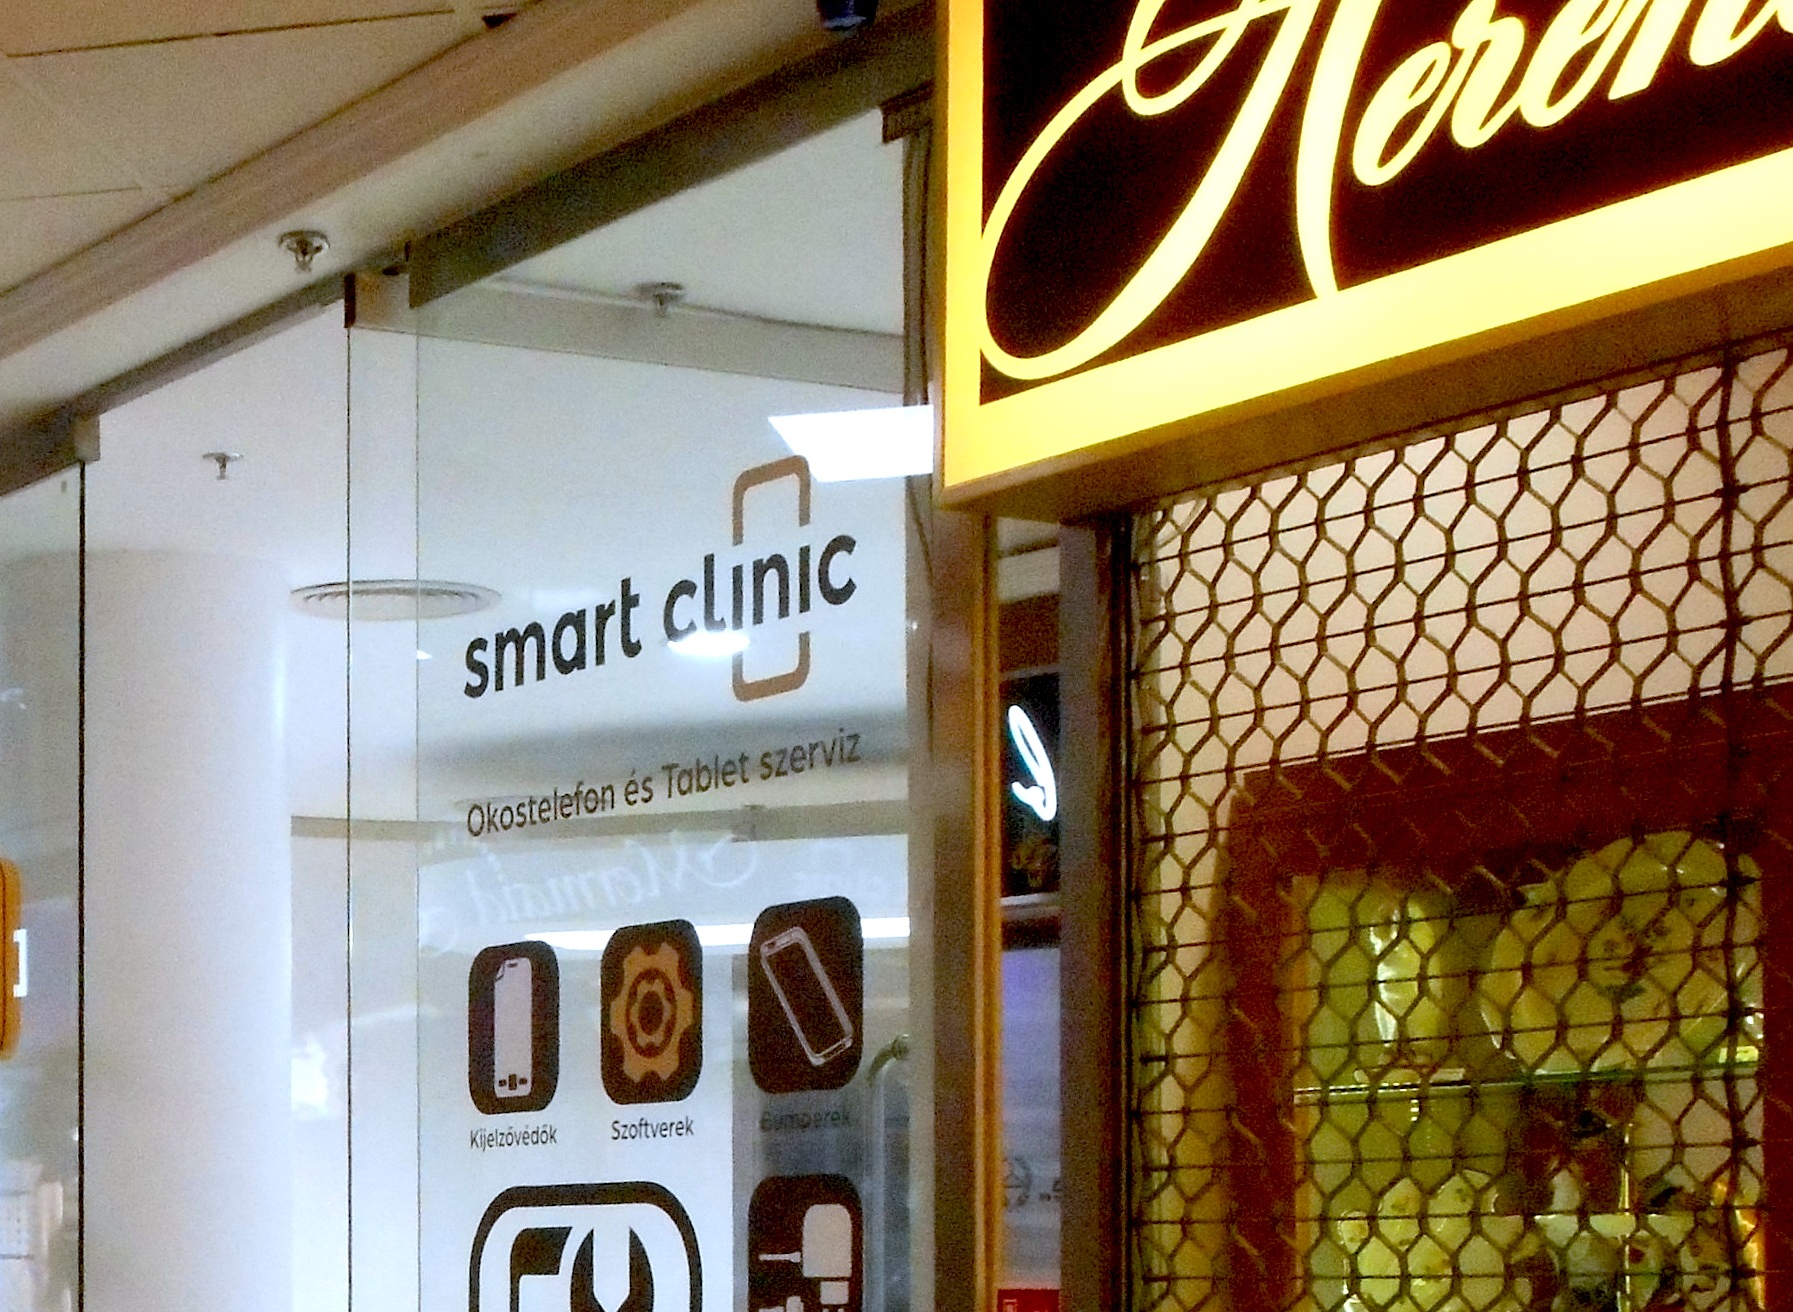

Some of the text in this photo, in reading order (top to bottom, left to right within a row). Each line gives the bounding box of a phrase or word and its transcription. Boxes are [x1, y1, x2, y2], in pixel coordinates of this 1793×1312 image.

[463, 534, 858, 699] smart clinic
[467, 727, 862, 838] Okostelefon és Tablet szerviz
[469, 1124, 557, 1154] Kijelzővédők
[611, 1117, 695, 1141] Szoftverek
